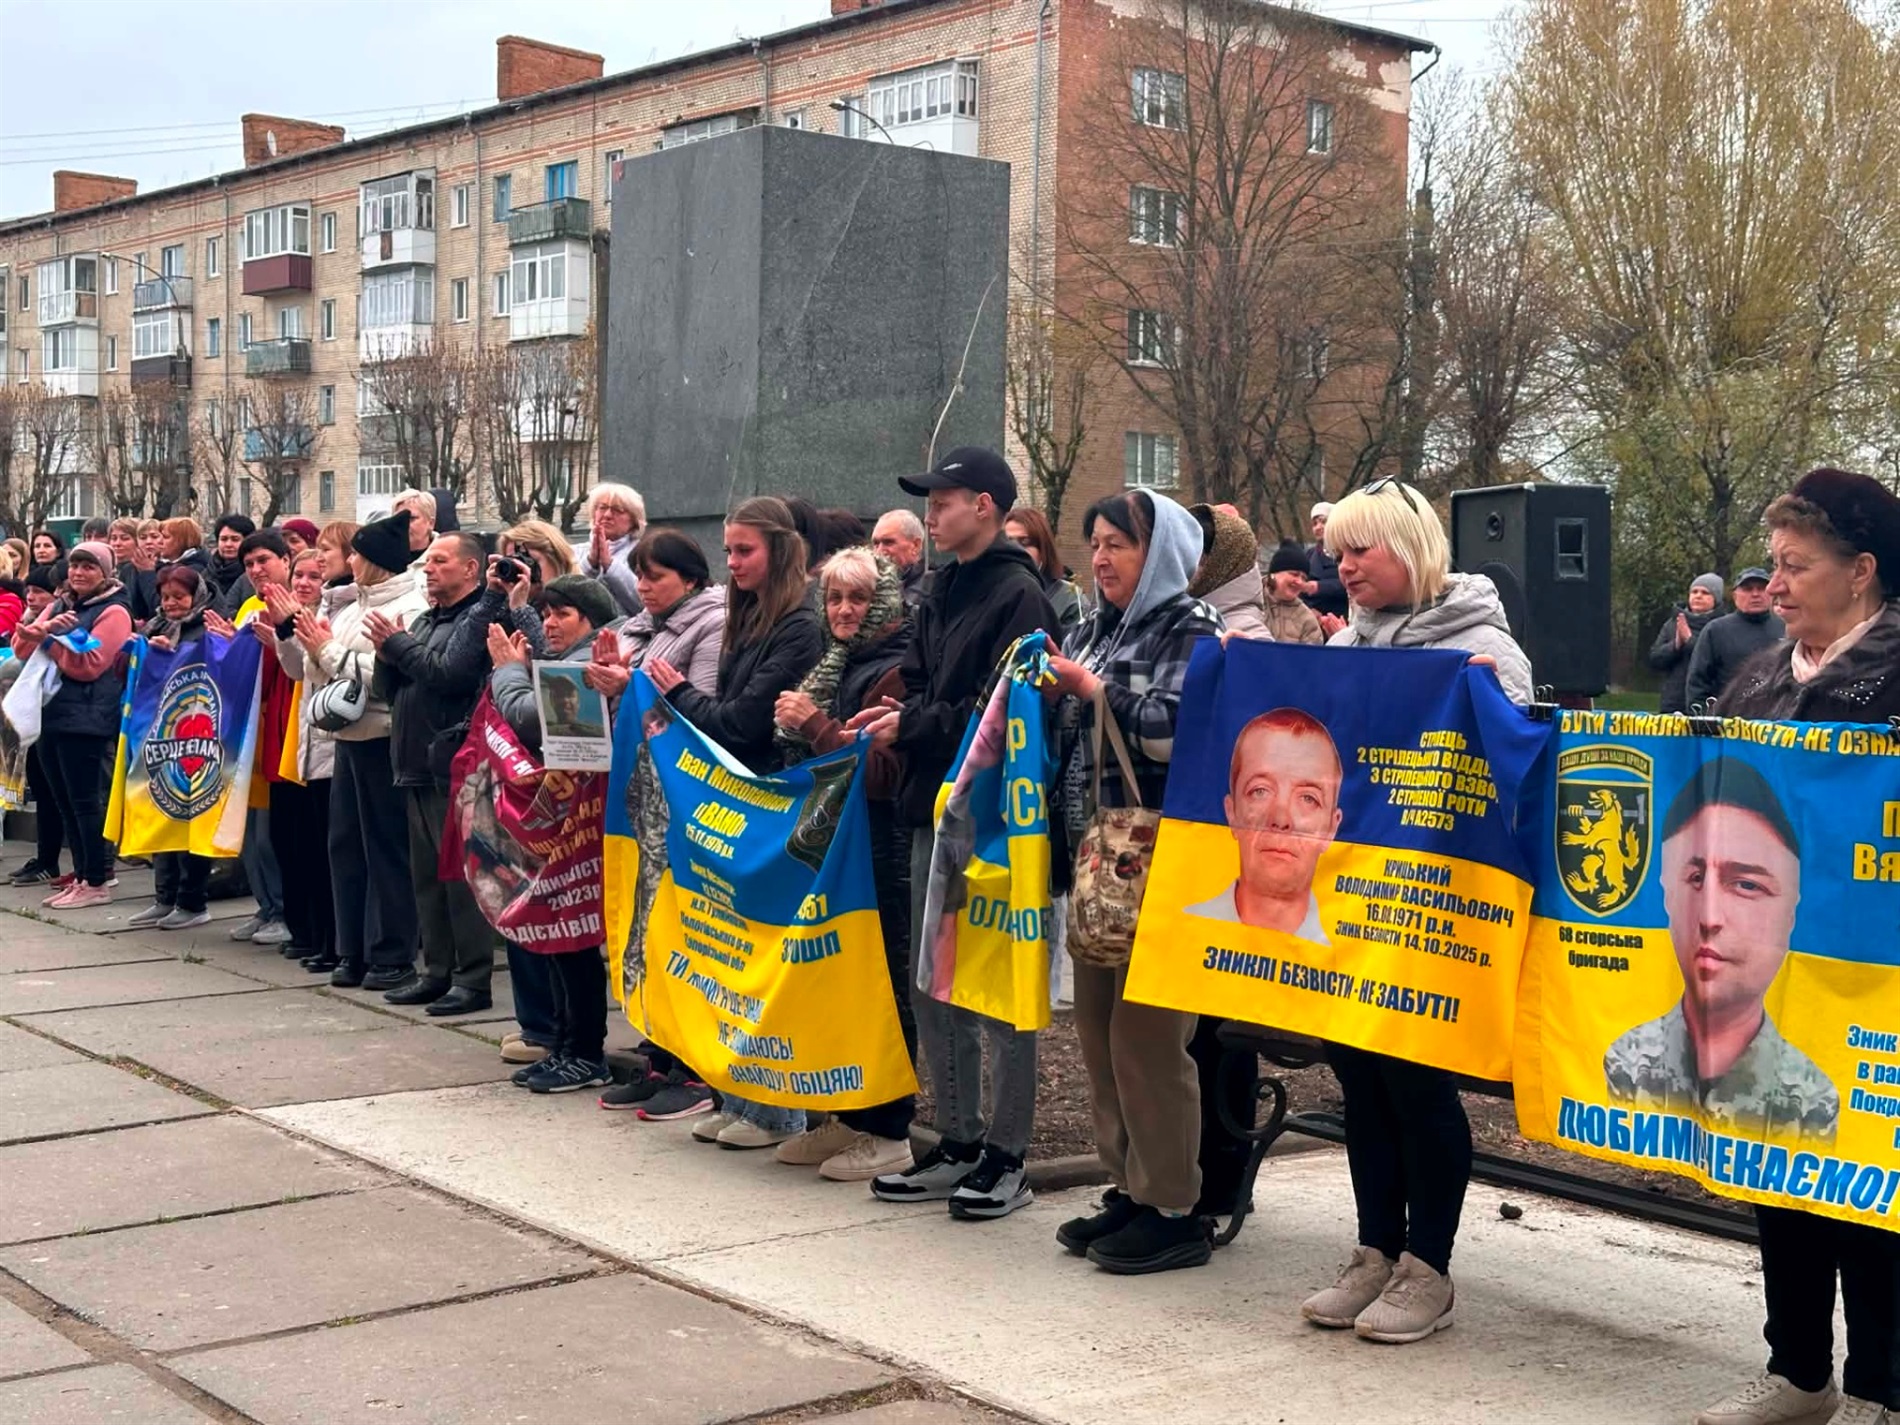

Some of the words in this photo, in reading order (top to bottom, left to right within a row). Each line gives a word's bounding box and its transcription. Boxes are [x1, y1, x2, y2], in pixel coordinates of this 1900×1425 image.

[1560, 711, 1606, 735] БУТИ
[1609, 713, 1691, 737] ЗНИКЛИ
[145, 740, 184, 764] СЕРЦЕ
[675, 748, 711, 782] Іван
[1357, 747, 1366, 763] 2
[1441, 752, 1491, 777] ВІДДІ
[1370, 767, 1379, 783] 3
[1455, 775, 1499, 802] ВЗВО
[1388, 788, 1396, 804] 2
[1446, 793, 1487, 817] РОТИ
[1384, 859, 1452, 887] КРИЦЬКИЙ
[1853, 843, 1900, 882] Вя
[1335, 875, 1401, 901] ВОЛОДИМИР
[1401, 886, 1515, 928] ВАСИЛЬОВИЧ
[1425, 916, 1457, 938] р.н.
[1559, 926, 1573, 942] 68
[1335, 920, 1362, 938] ЗНИК
[1404, 933, 1477, 963] 14.10.2025
[1479, 951, 1492, 967] р.
[665, 950, 690, 979] ТИ
[1568, 950, 1629, 972] бригада
[1203, 946, 1277, 982] ЗНИКЛІ
[1279, 959, 1354, 1000] БЕЗВІСТИ
[1358, 979, 1377, 1004] НЕ
[1376, 982, 1461, 1023] ЗАБУТІ!
[1847, 1025, 1898, 1053] Зник
[728, 1063, 788, 1094] ЗНАЙДУ!
[789, 1065, 864, 1096] ОБІЦЯЮ!
[1856, 1061, 1870, 1080] в
